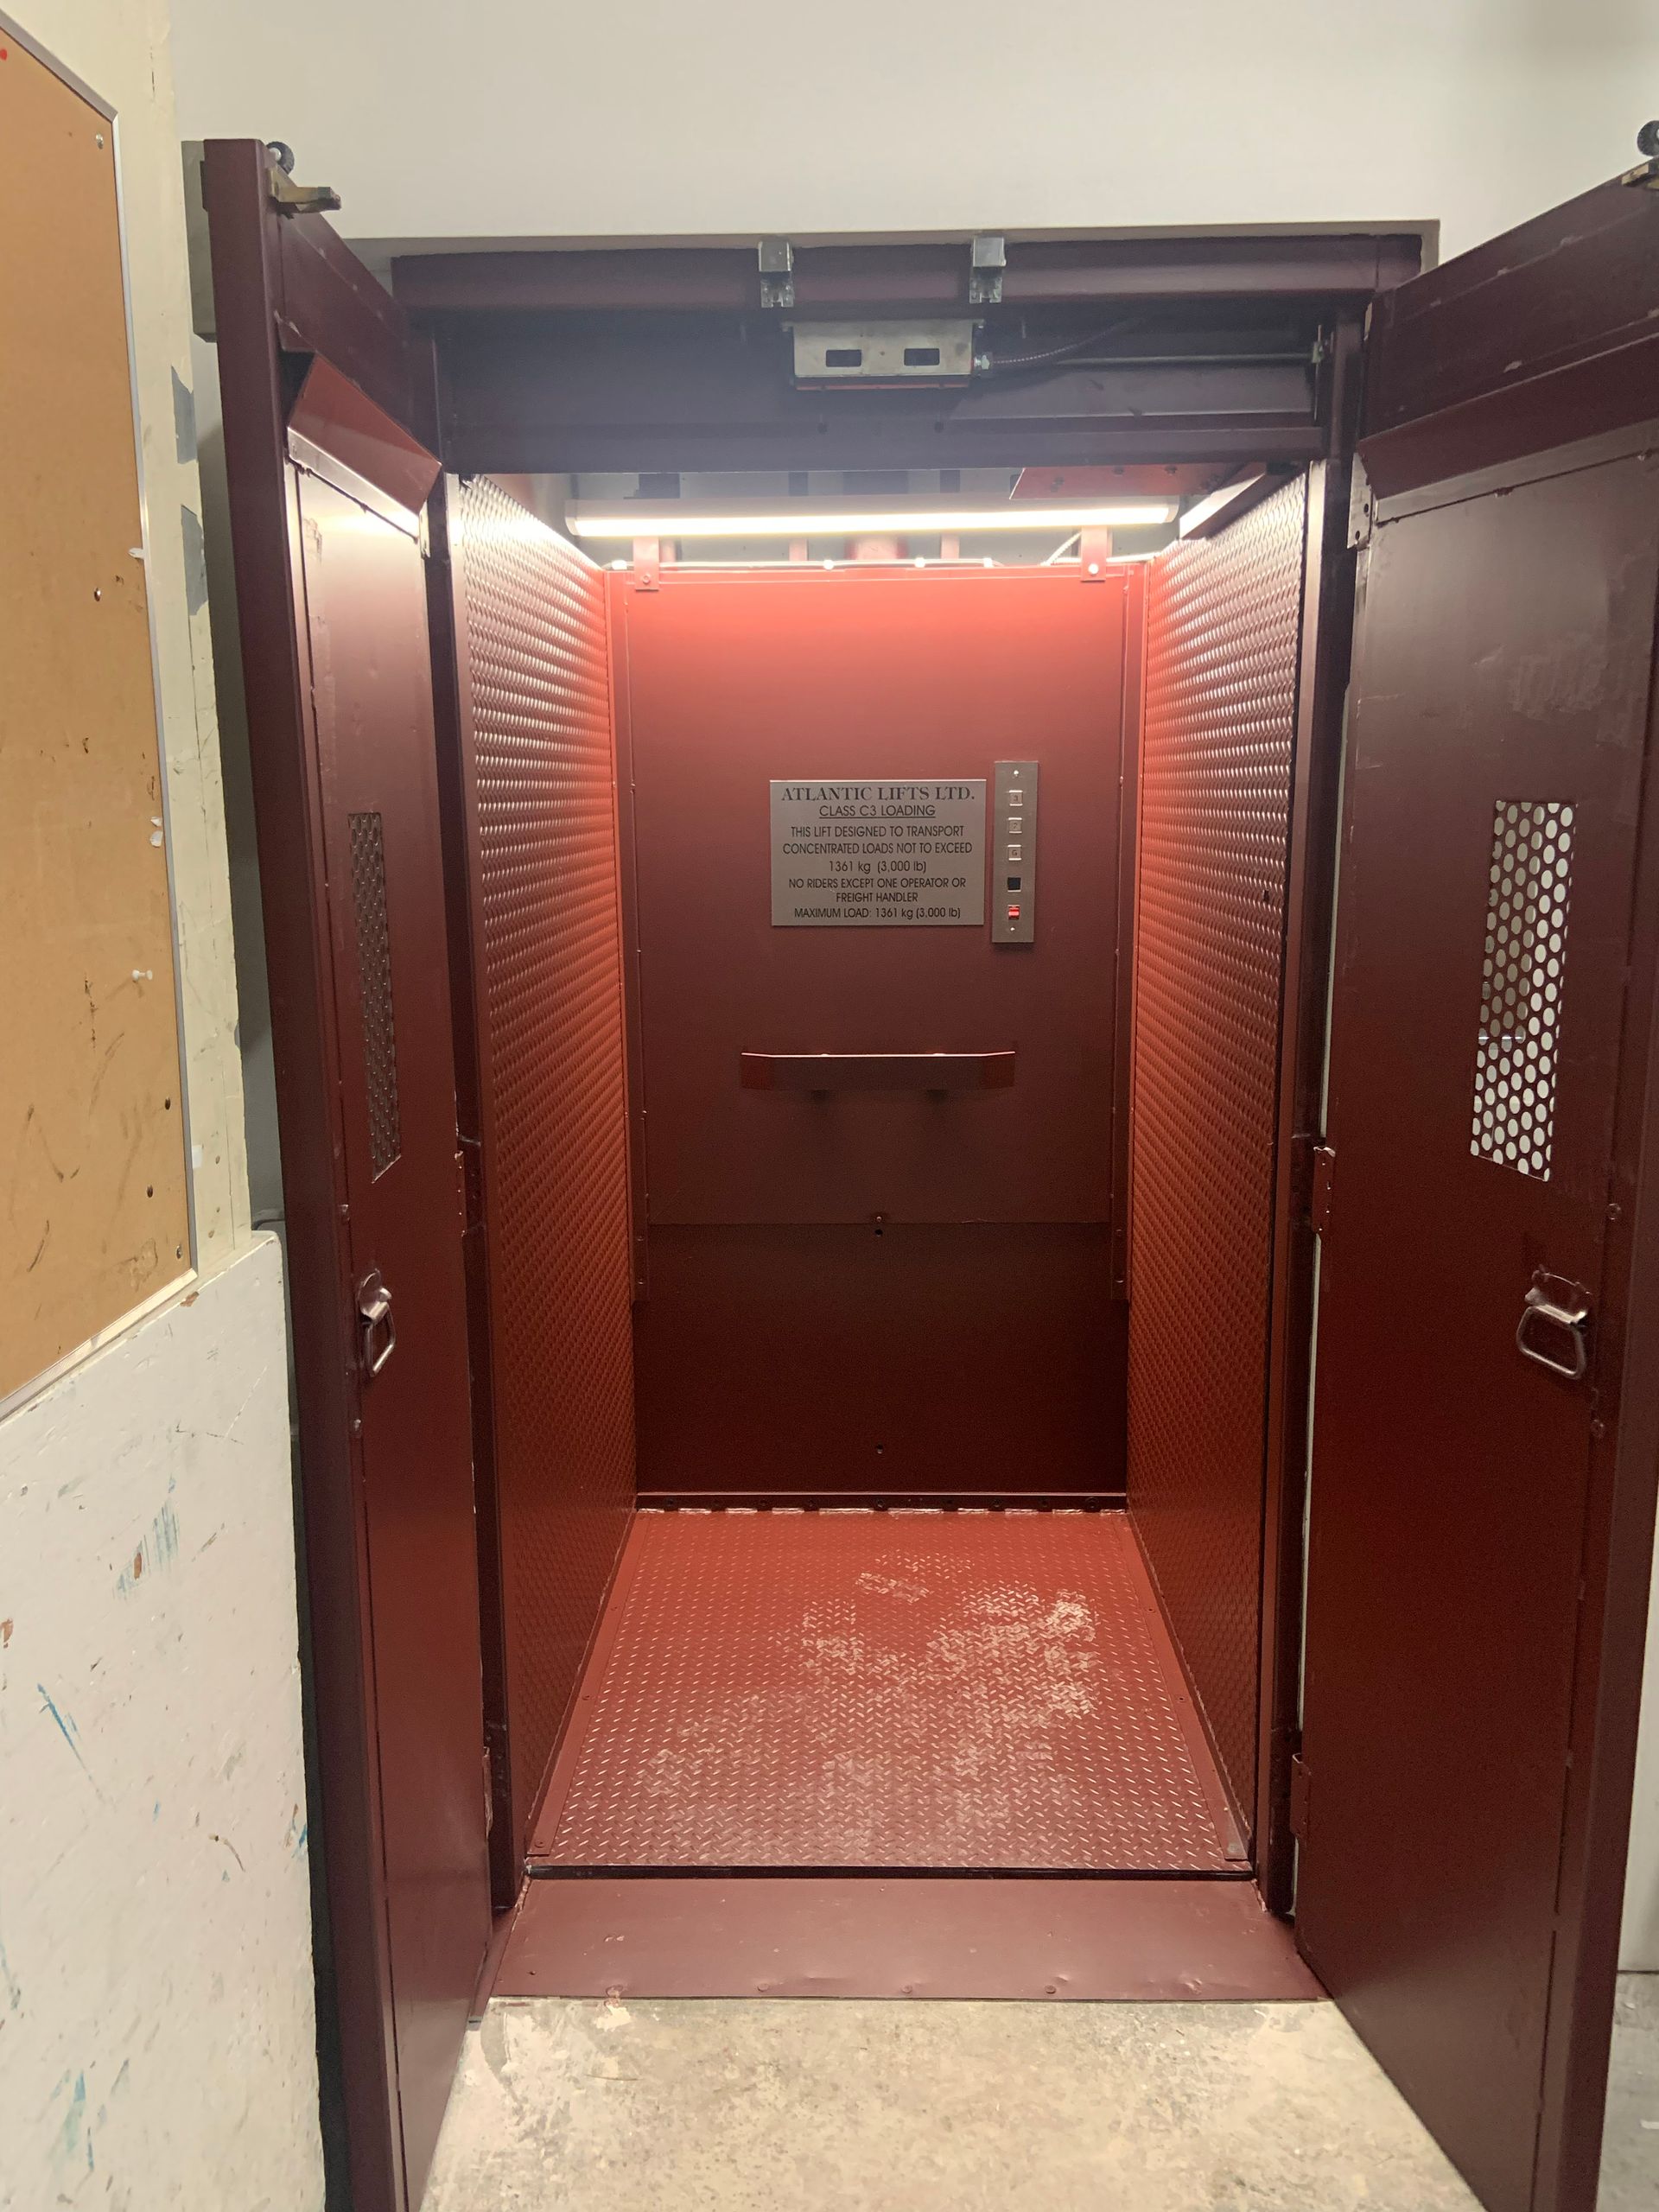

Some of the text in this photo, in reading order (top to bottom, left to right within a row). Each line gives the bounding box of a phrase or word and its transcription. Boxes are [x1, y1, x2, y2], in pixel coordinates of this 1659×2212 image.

[781, 786, 975, 801] ATLANTIC LIFTS LTD.
[819, 804, 936, 817] CLASS C3 LOADING
[791, 825, 964, 837] THIS LIFT DESIGNED TO TRANSPORT
[783, 842, 973, 855] CONCENTRATED LOADS NOT TO EXCEED
[830, 861, 853, 872] 1361
[858, 861, 871, 874] kg
[913, 861, 926, 874] lb)
[788, 878, 966, 888] NO RIDERS EXCEPT ONE OPERATOR OR
[836, 893, 918, 903] FREIGHT HANDLER
[794, 908, 841, 918] MAXIMUM
[843, 907, 872, 918] LOAD:
[875, 907, 897, 918] 1361
[901, 908, 913, 920] kg
[949, 907, 961, 919] lb)
